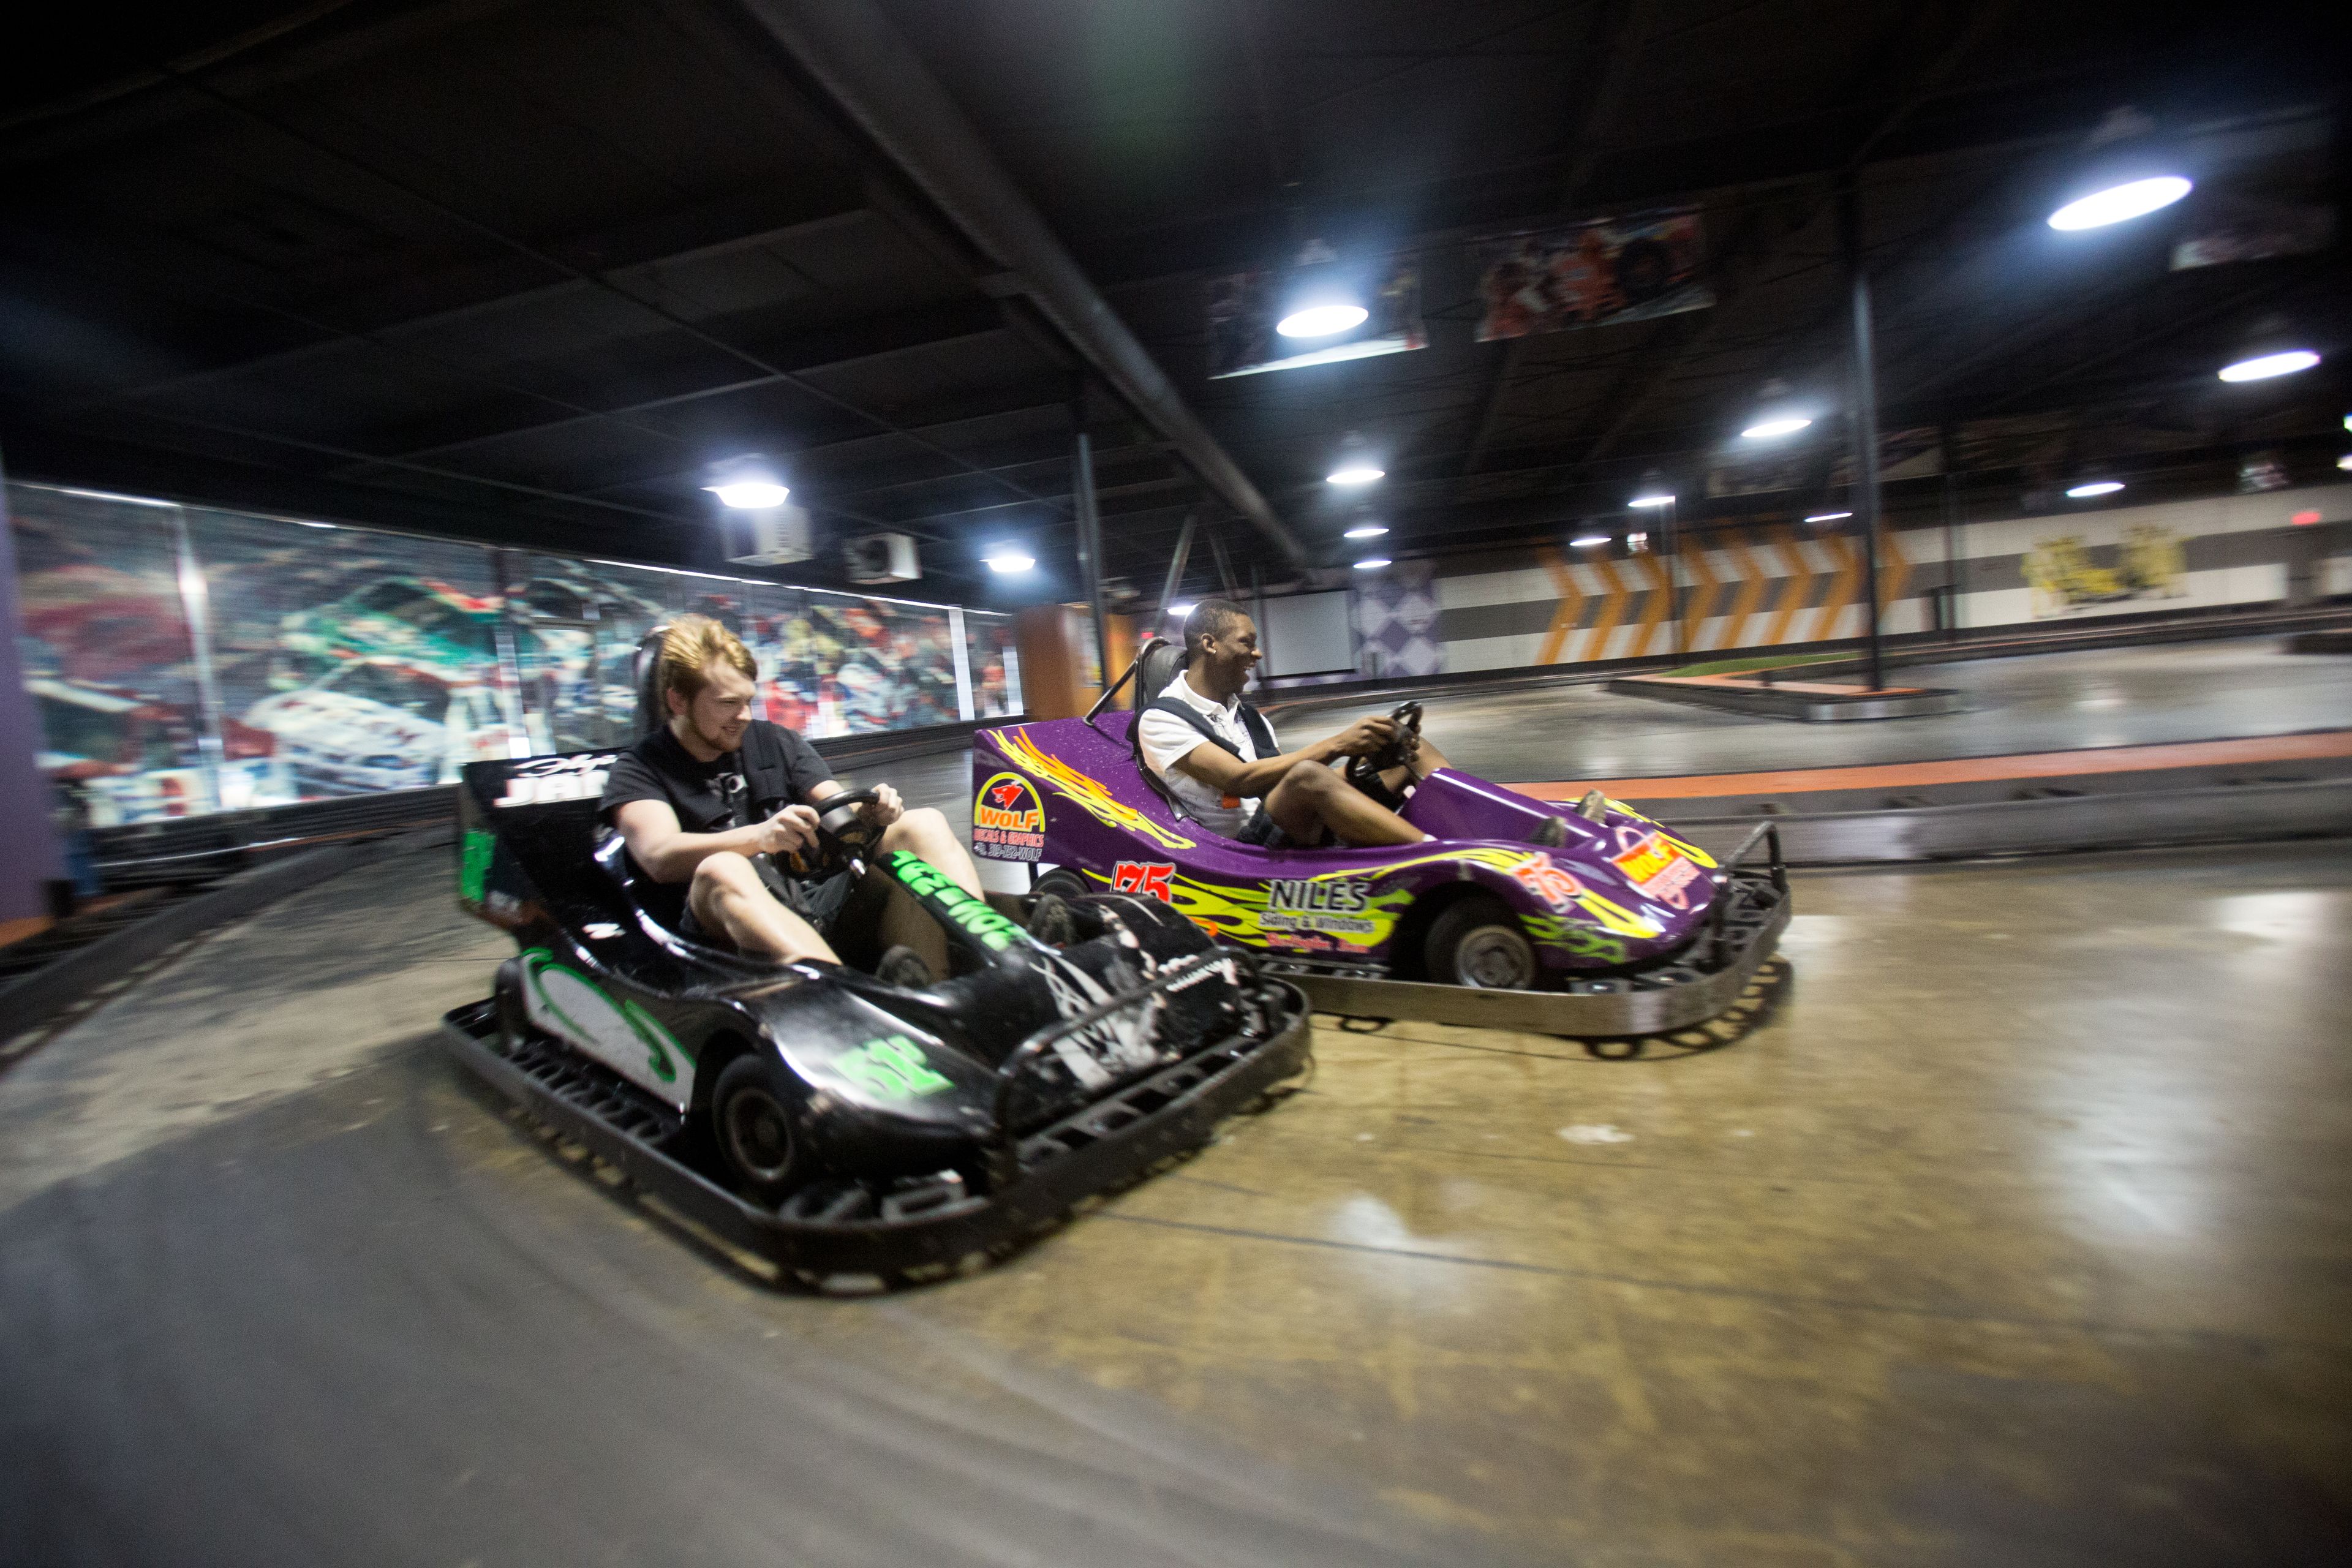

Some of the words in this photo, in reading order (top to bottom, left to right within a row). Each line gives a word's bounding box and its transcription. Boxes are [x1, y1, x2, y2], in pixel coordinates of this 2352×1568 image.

[979, 805, 1040, 831] WOLF
[1008, 831, 1044, 848] GRAPHICS
[1110, 861, 1177, 903] 75
[1268, 879, 1371, 914] NILES
